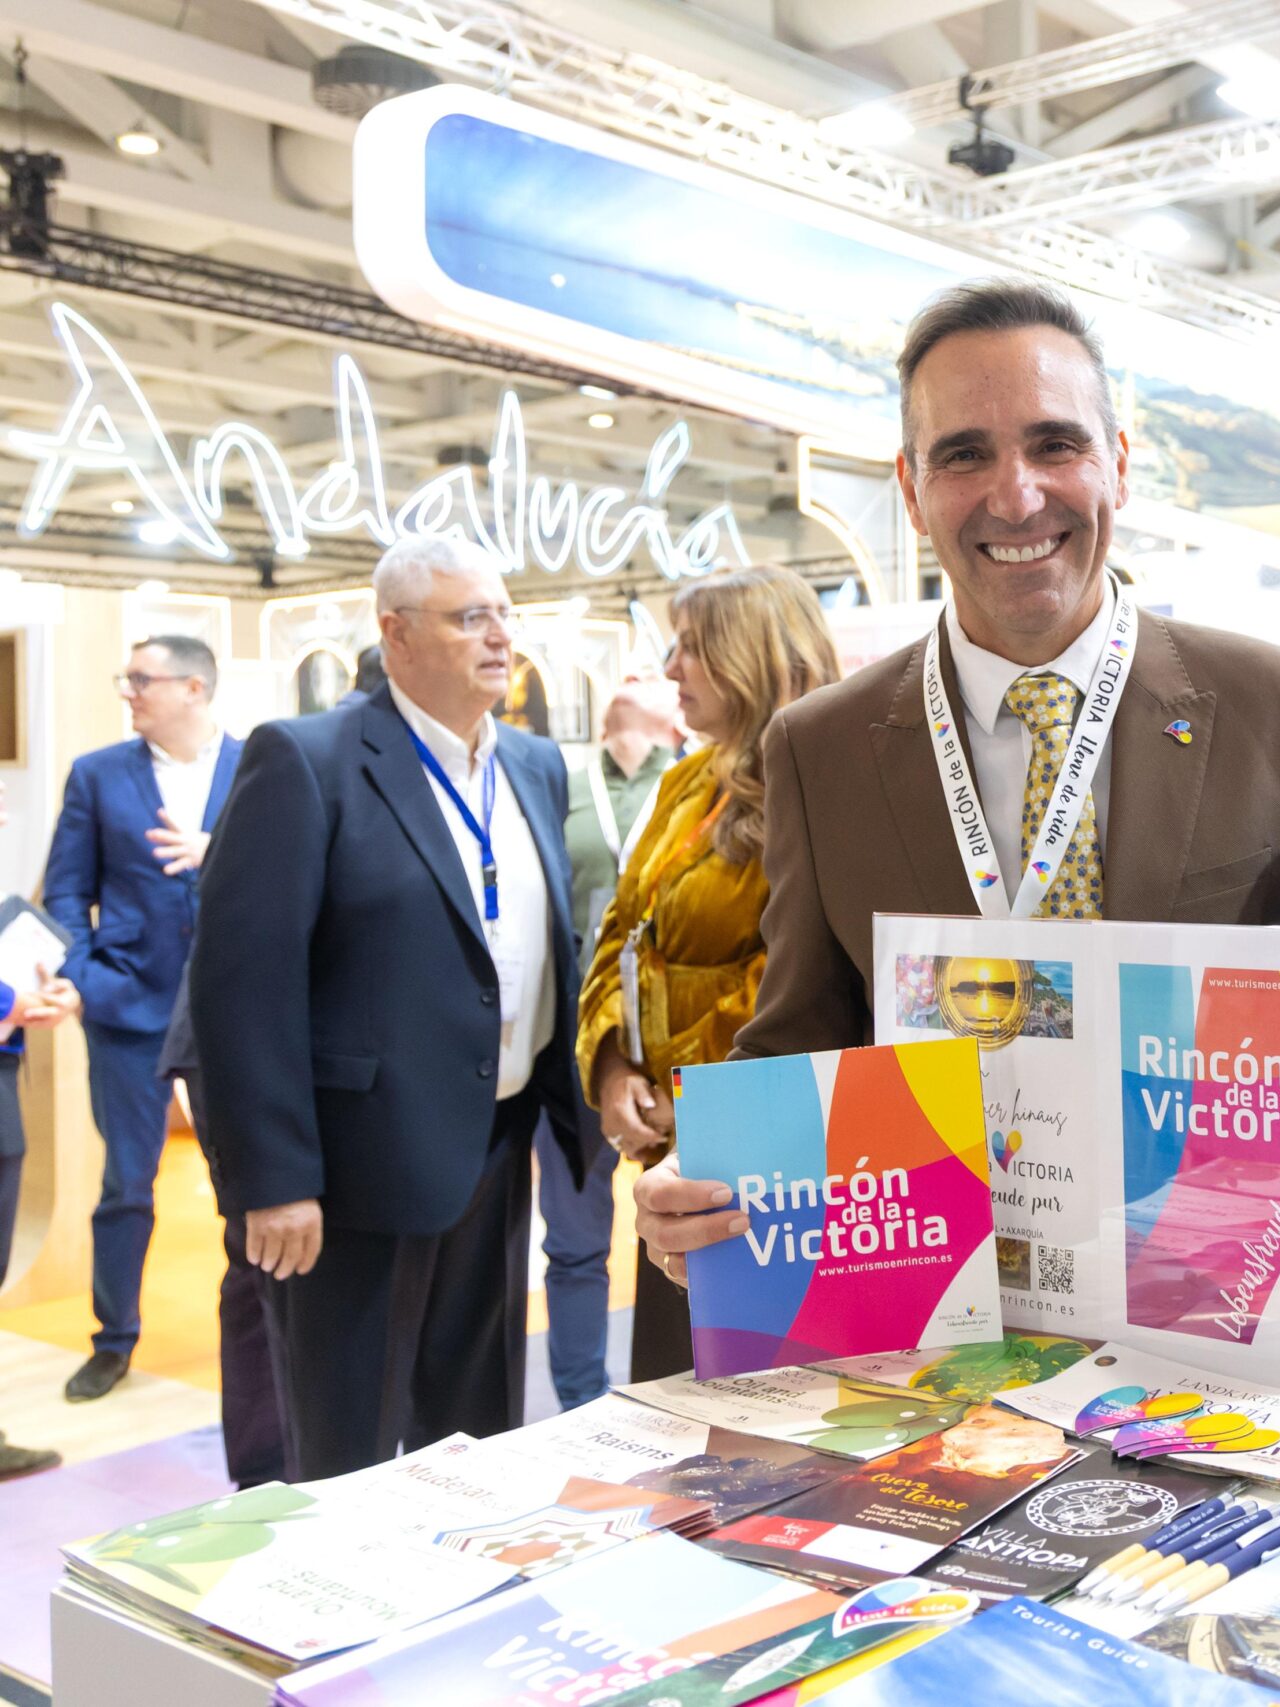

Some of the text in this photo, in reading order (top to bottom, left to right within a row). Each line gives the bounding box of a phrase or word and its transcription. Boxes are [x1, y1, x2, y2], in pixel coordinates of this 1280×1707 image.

[6, 301, 750, 581] Andalucía
[943, 739, 957, 759] la
[1068, 735, 1098, 780] Lleno
[949, 760, 964, 781] de
[1059, 784, 1079, 805] de
[953, 788, 988, 857] RINCÓN
[1044, 808, 1068, 848] vida
[1225, 1082, 1279, 1110] de la
[738, 1156, 910, 1215] Rincón
[841, 1198, 901, 1226] de la
[1031, 1196, 1064, 1216] pur
[744, 1208, 949, 1267] Victoria
[1005, 1225, 1044, 1240] AXARQUÍA
[818, 1253, 954, 1278] www.turismoenrincon.es
[732, 1377, 767, 1390] Oil
[761, 1384, 807, 1400] and
[585, 1431, 675, 1462] Raisins
[869, 1473, 930, 1490] Cueva
[904, 1488, 970, 1510] Tesoro
[981, 1525, 1048, 1549] VILLA
[956, 1535, 1090, 1569] ANTIOPA
[1011, 1604, 1150, 1669] Tourist Guide
